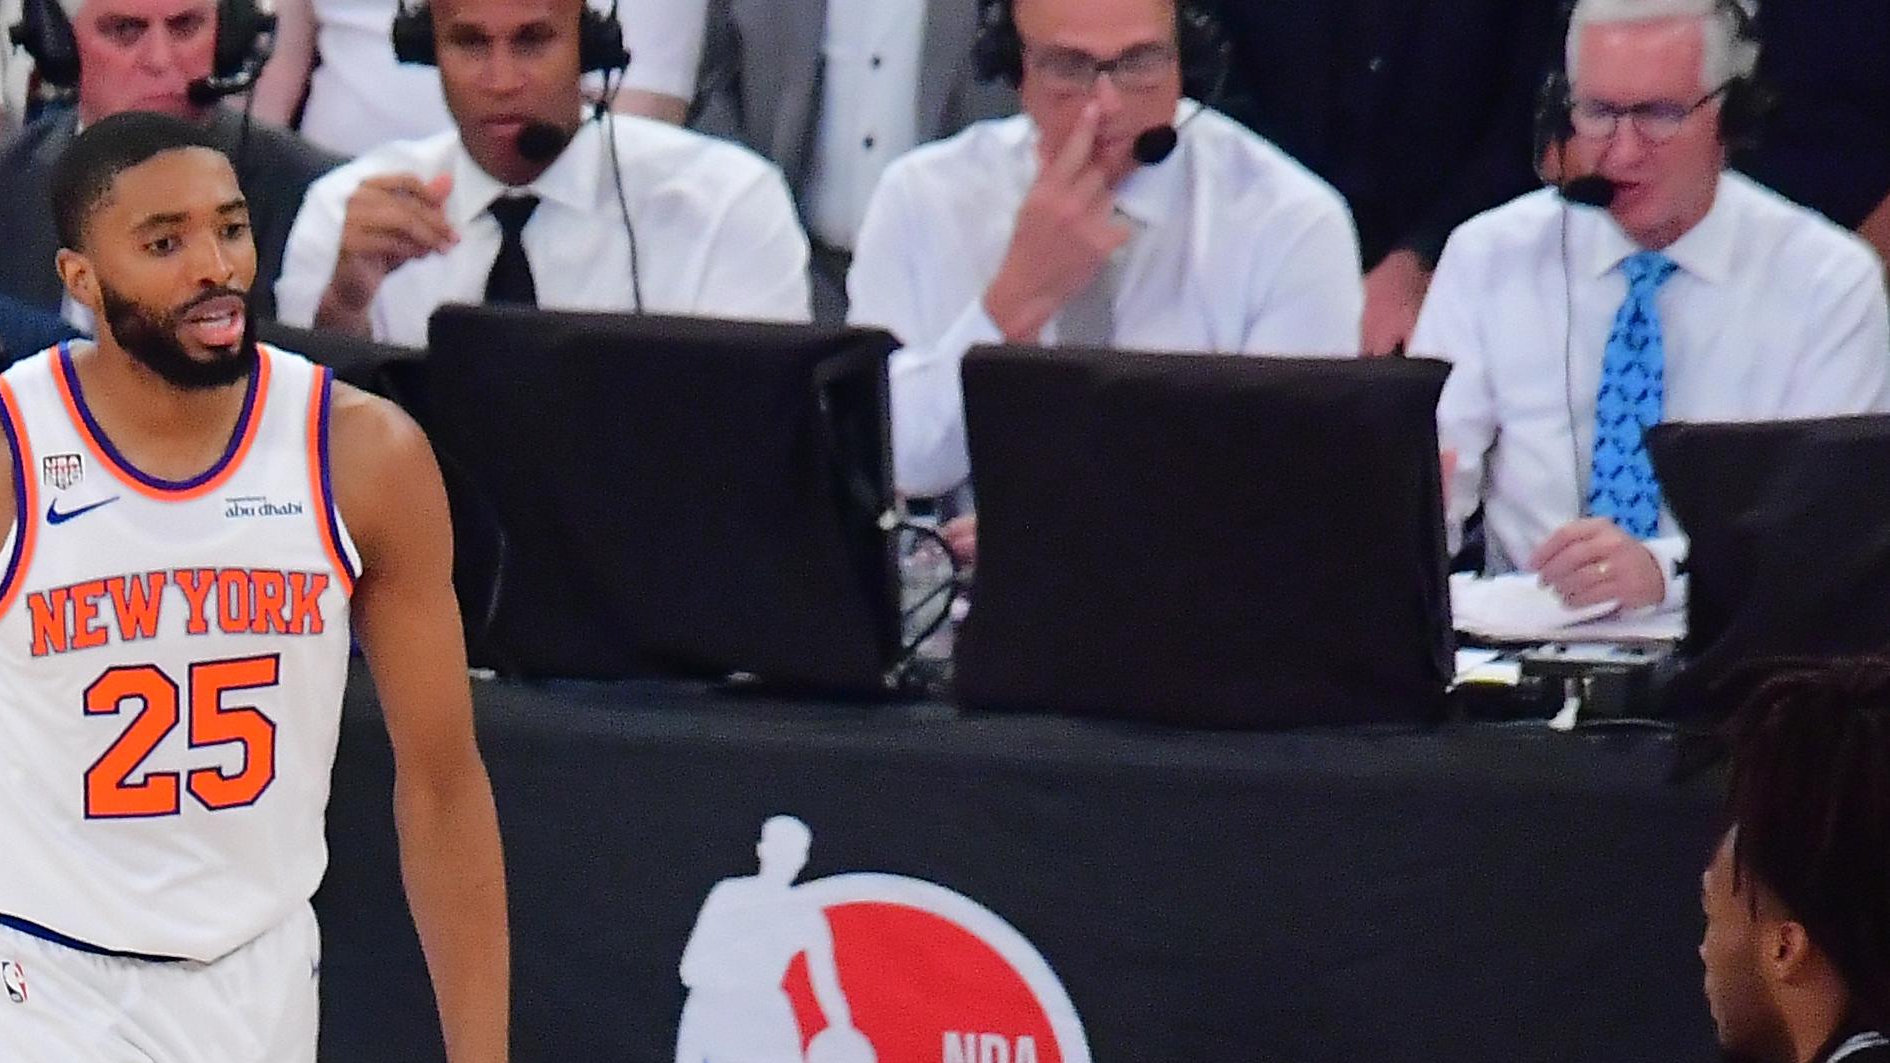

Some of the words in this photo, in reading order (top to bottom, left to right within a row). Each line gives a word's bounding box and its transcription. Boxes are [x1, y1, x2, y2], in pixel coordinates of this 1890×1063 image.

[27, 570, 167, 657] NEW
[172, 567, 329, 635] YORK
[83, 652, 281, 820] 25
